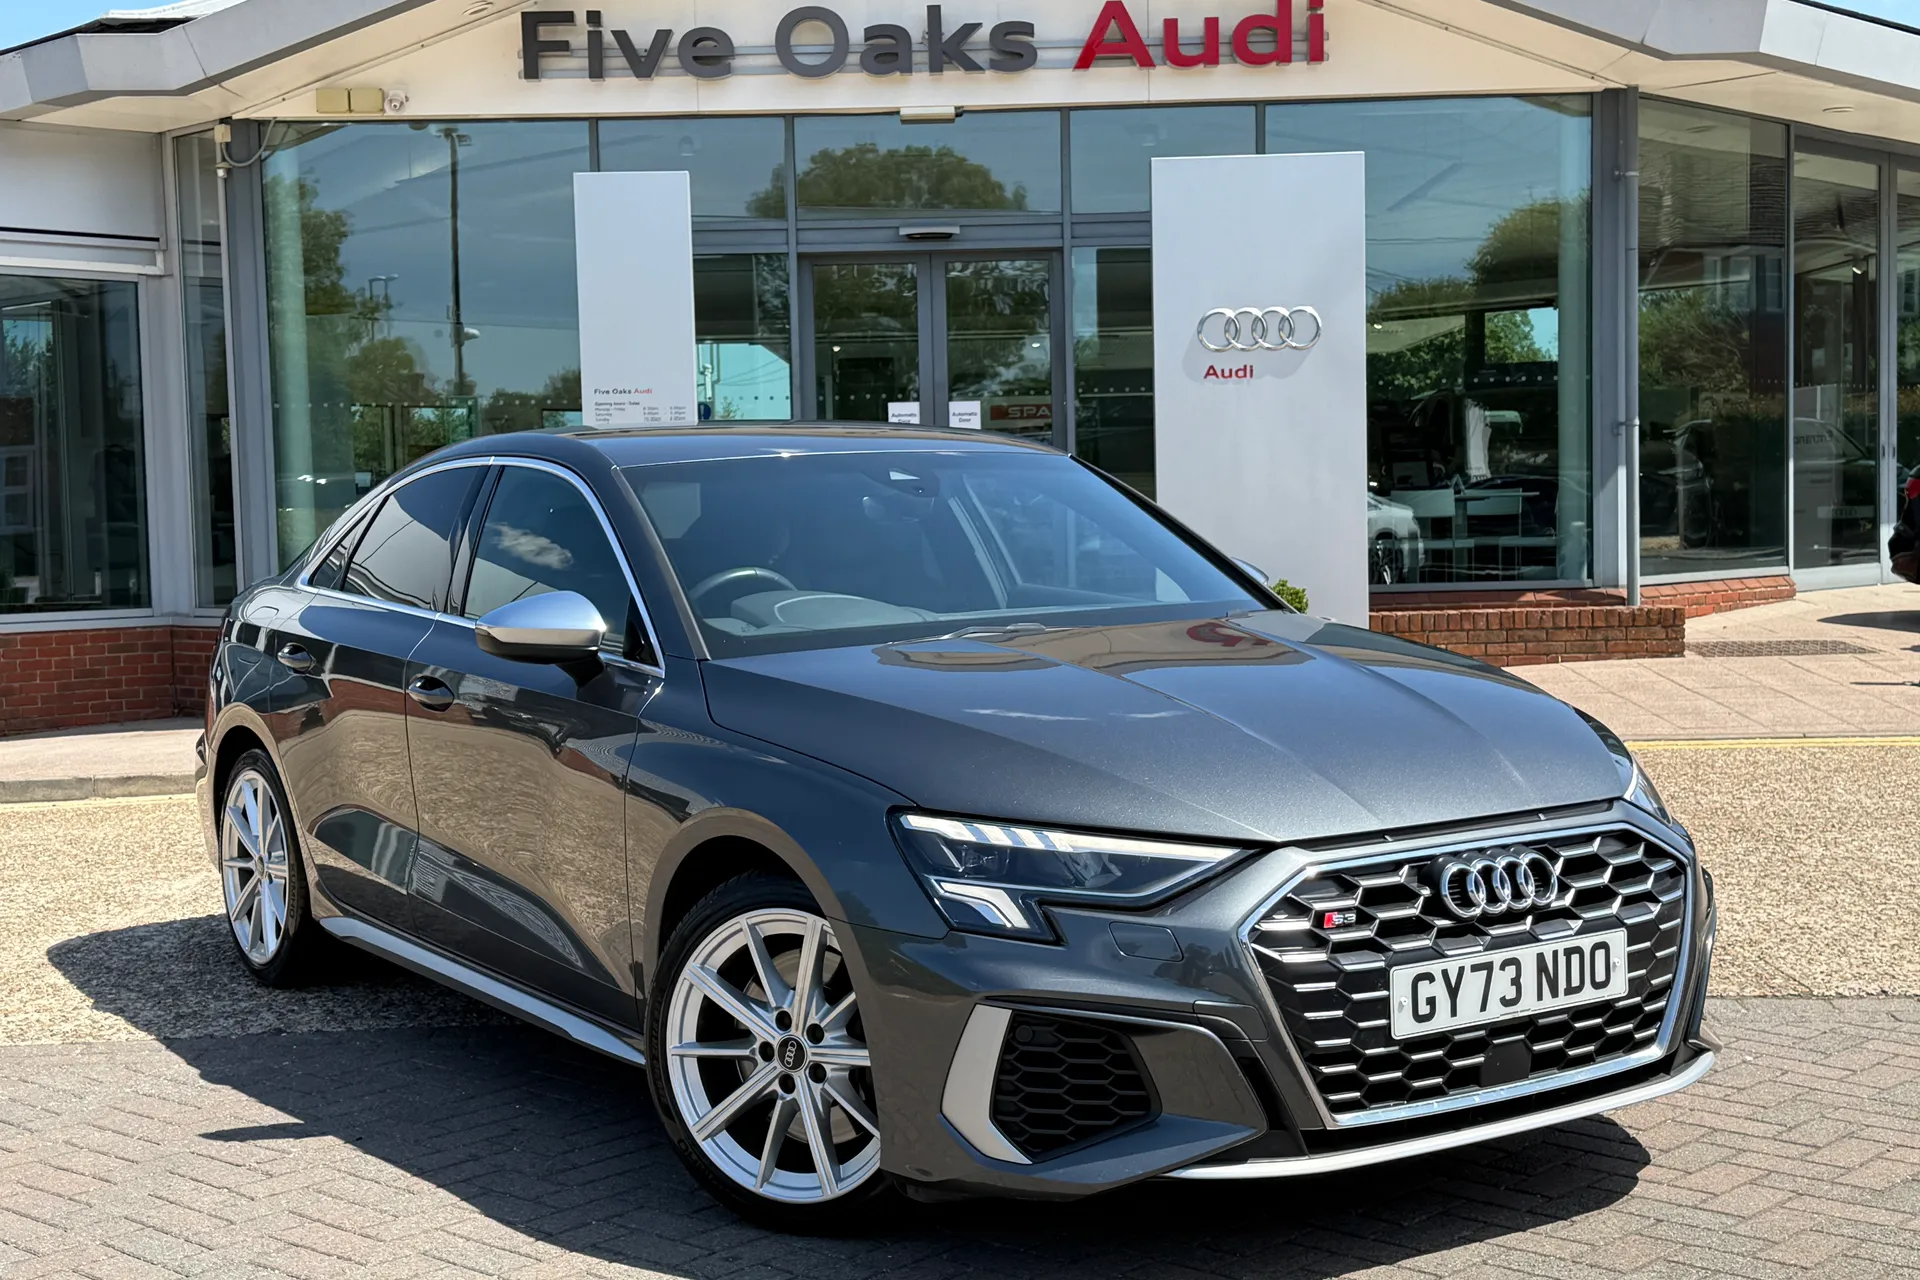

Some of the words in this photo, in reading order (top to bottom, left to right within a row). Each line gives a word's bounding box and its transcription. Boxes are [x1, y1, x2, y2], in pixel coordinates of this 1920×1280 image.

[521, 10, 735, 82] Five
[775, 4, 1038, 80] Oaks
[1072, 0, 1325, 71] Audi
[1203, 364, 1254, 379] Audi
[1331, 912, 1356, 925] S3
[1411, 957, 1522, 1023] GY73
[1536, 940, 1612, 1001] NDO
